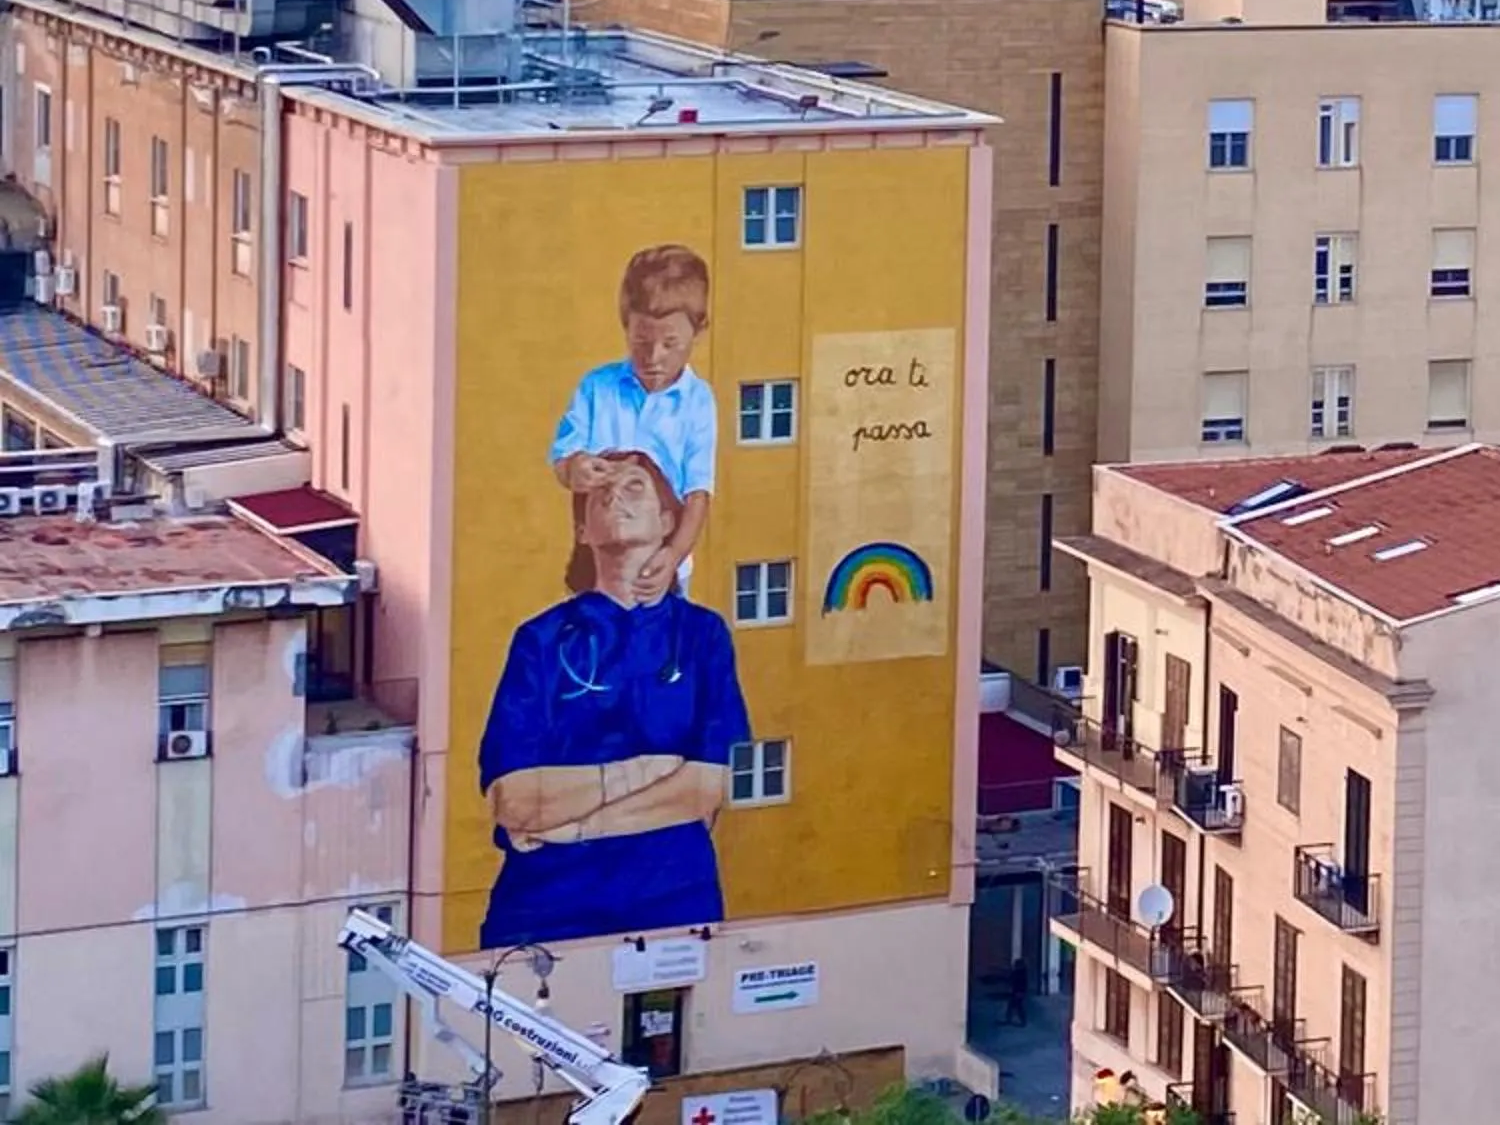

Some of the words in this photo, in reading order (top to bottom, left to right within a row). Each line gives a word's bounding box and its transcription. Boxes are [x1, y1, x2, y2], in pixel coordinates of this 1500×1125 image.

[844, 366, 896, 387] ora
[908, 356, 929, 387] ti
[852, 420, 932, 452] passa
[503, 1018, 579, 1064] costruzioni
